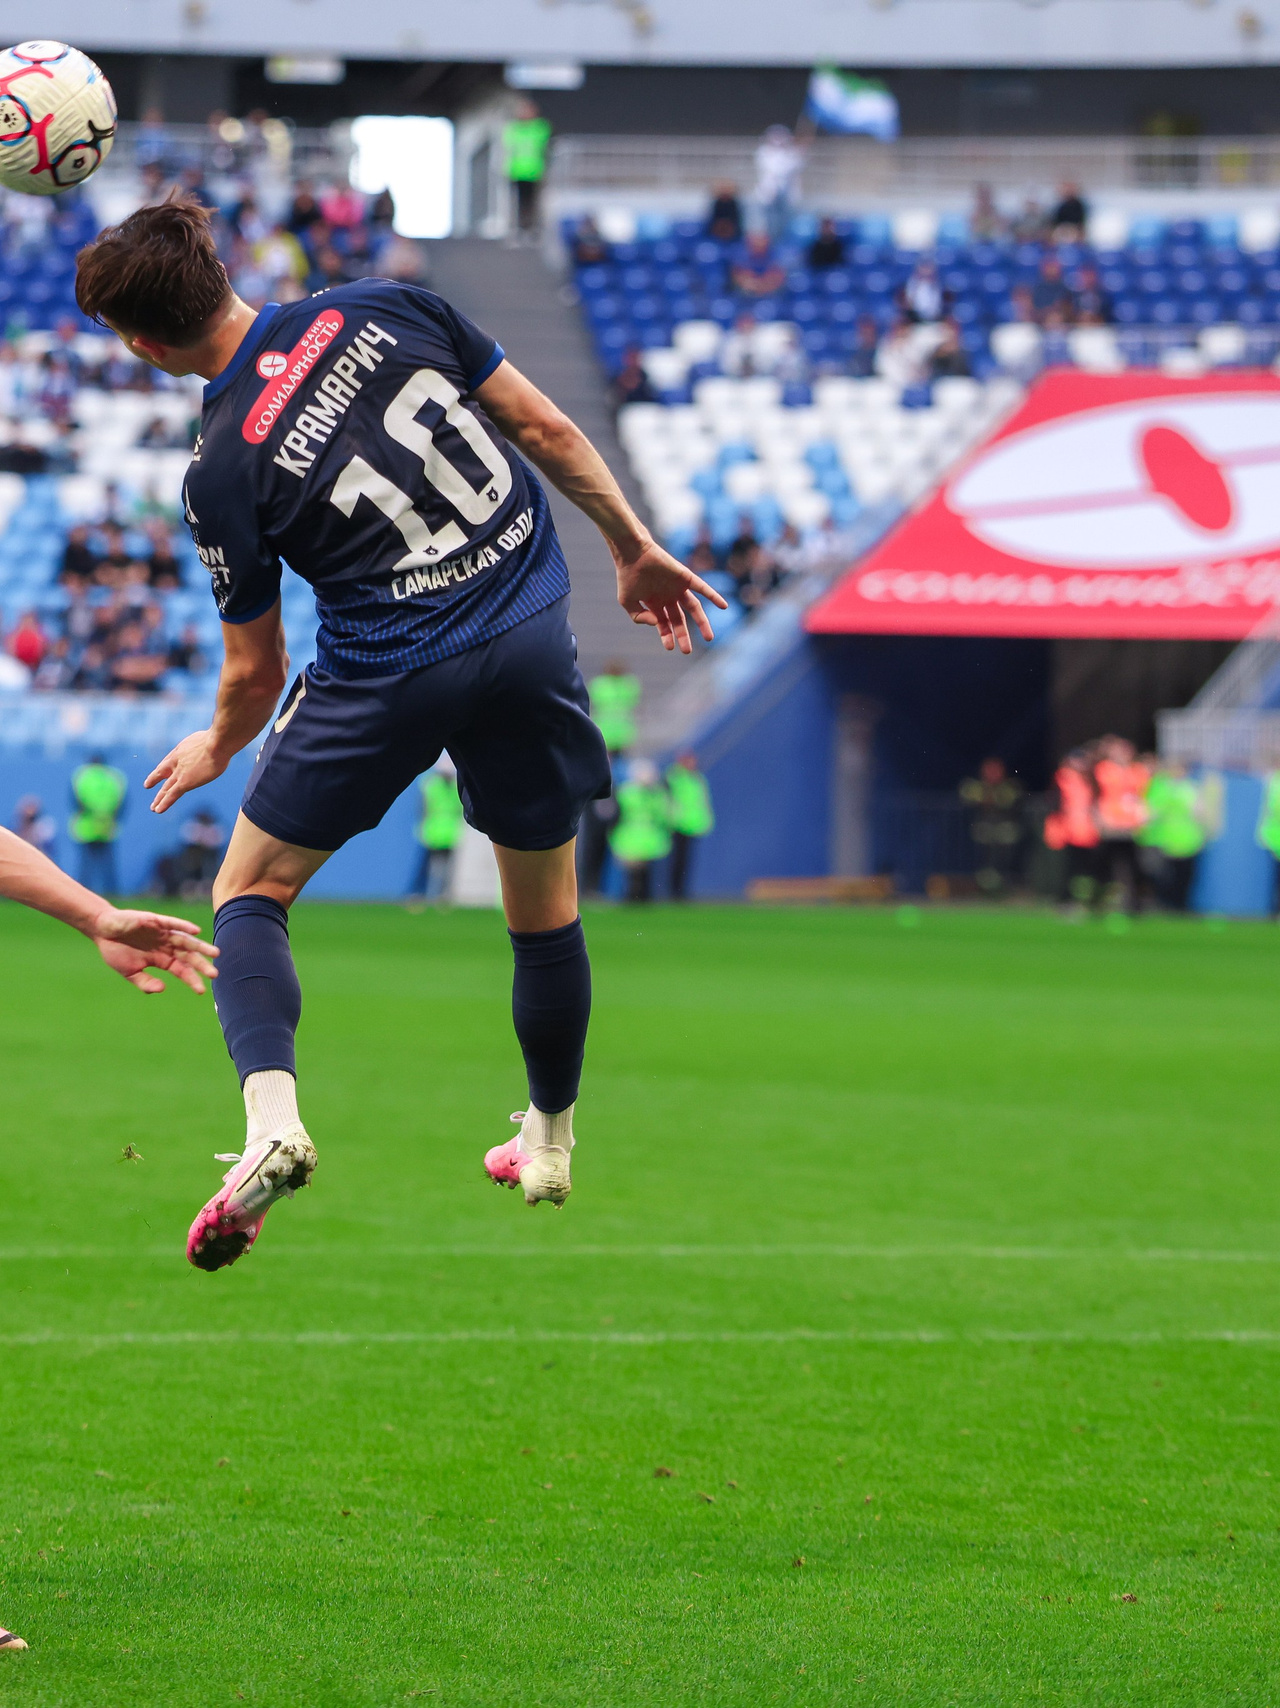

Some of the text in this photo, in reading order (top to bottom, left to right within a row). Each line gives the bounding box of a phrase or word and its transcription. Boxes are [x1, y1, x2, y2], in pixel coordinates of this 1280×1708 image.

[255, 321, 340, 436] СОЛИДАРНОСТЬ
[301, 320, 325, 346] БАНК
[273, 321, 398, 479] КРАМАРИЧ
[329, 368, 513, 573] 10
[391, 546, 502, 600] САМАРСКАЯ
